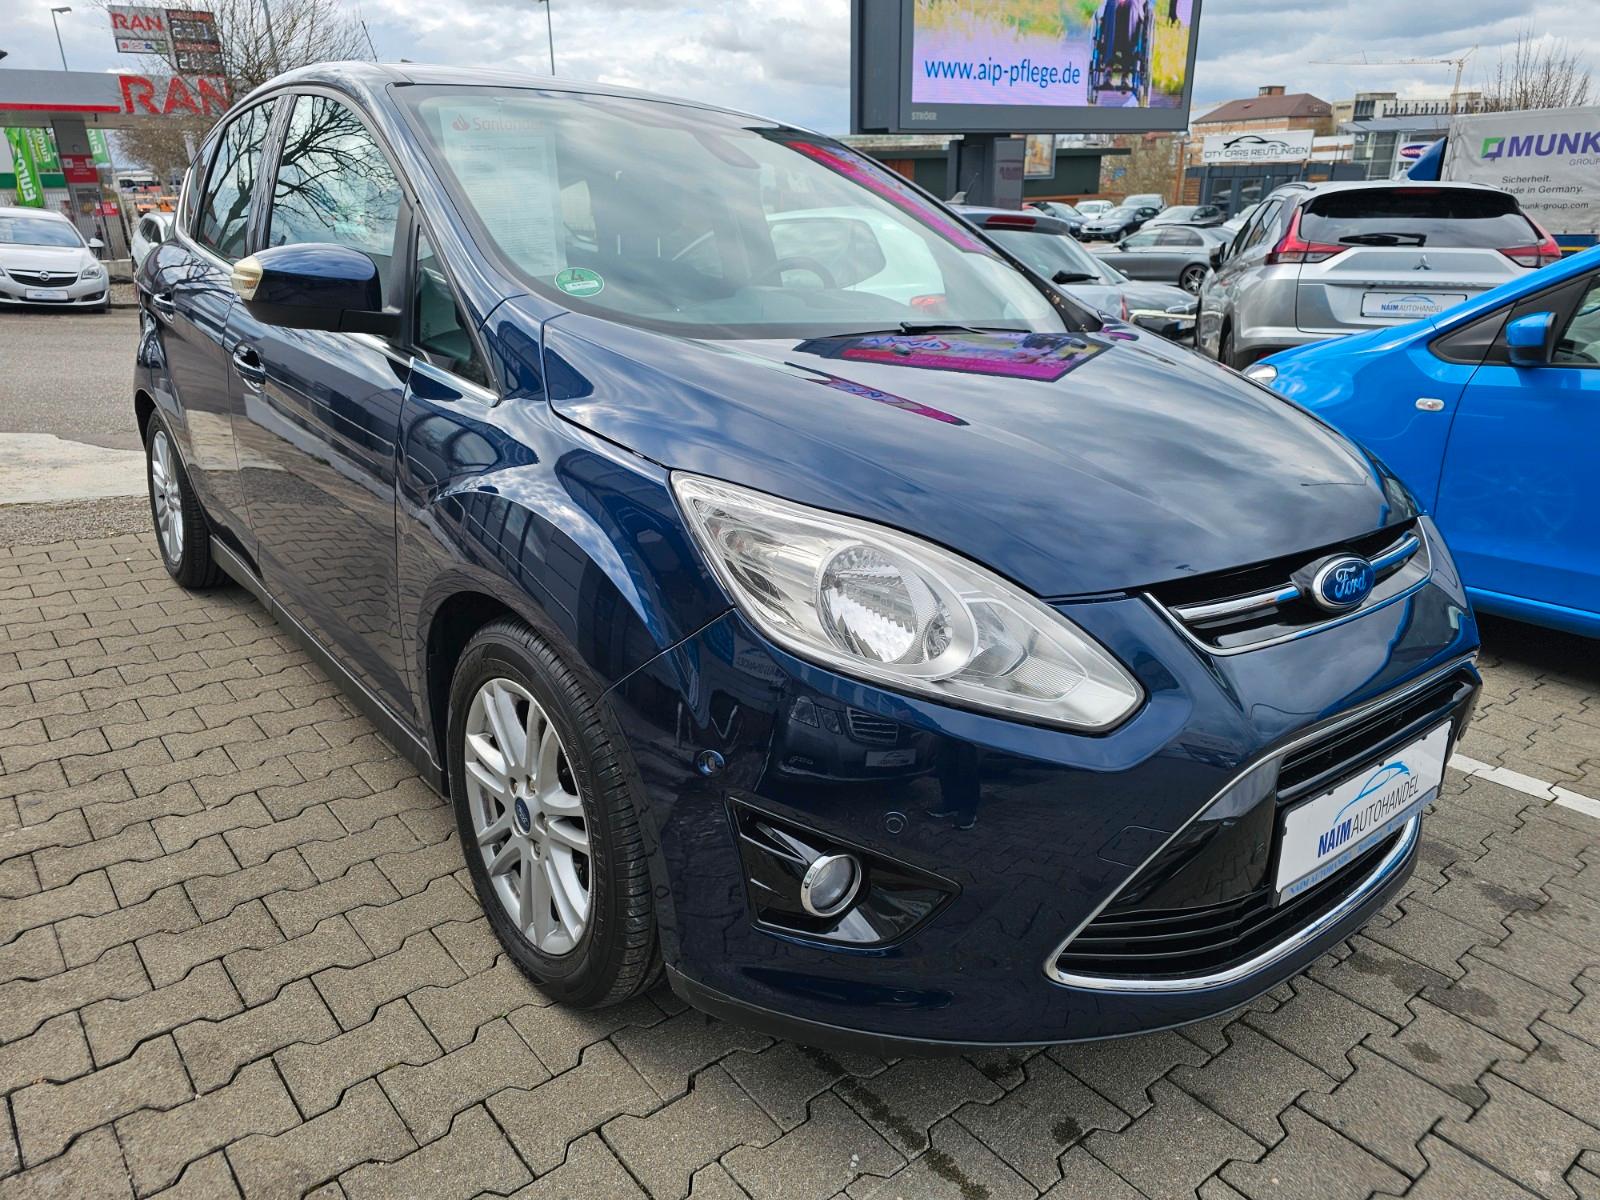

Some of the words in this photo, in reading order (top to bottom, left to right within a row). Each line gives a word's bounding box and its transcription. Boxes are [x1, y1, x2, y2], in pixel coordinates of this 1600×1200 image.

[111, 12, 164, 32] RAN
[925, 57, 1081, 88] www.aip-pflege.de
[119, 75, 231, 114] RAN
[1225, 148, 1249, 158] CARS
[1251, 146, 1309, 157] REUTLINGEN
[1507, 131, 1600, 158] MUNK
[1502, 175, 1552, 184] Sicherheit.
[1538, 186, 1584, 195] Germany.
[1334, 566, 1367, 598] Ford
